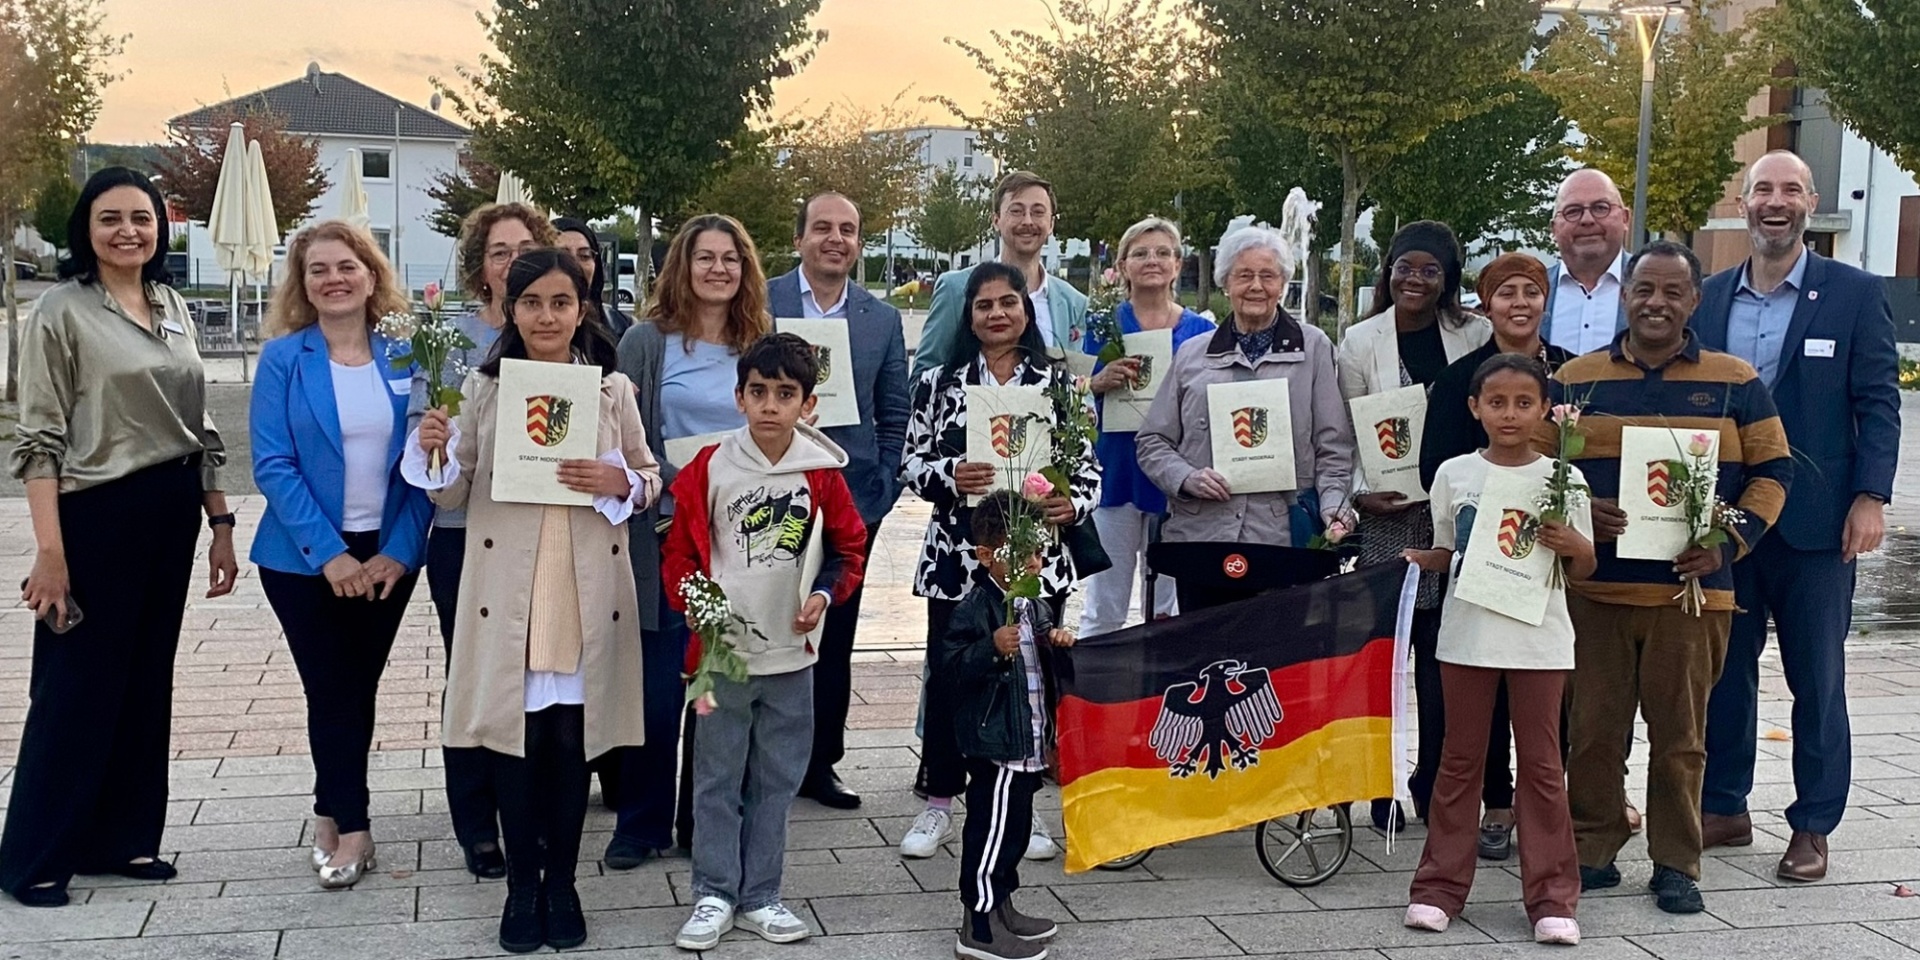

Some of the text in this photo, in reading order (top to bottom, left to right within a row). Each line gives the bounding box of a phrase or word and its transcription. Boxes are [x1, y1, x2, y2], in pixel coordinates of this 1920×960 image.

[519, 454, 539, 462] STADT
[1485, 560, 1532, 580] STADT NIDDERAU
